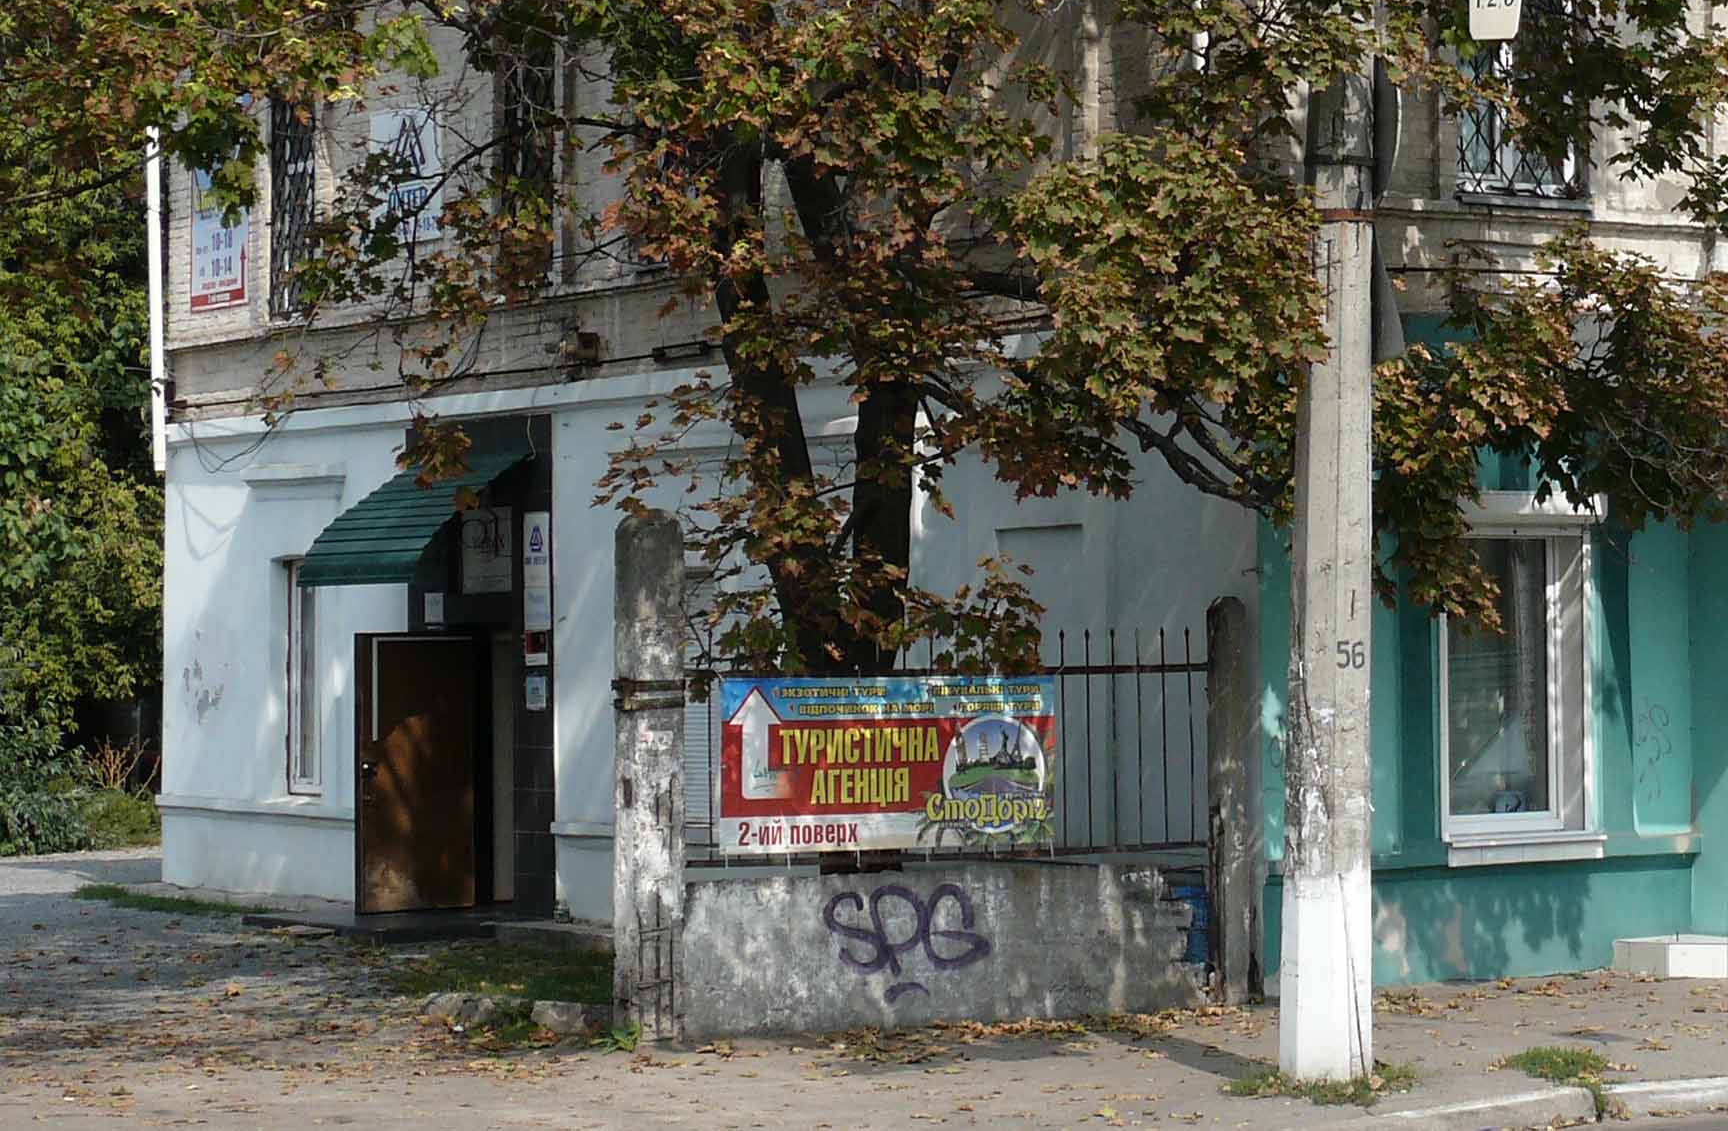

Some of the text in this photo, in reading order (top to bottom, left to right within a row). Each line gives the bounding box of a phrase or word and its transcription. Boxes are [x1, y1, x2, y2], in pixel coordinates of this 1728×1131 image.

[1336, 640, 1366, 669] 56
[779, 726, 940, 766] ТУРИСТИЧНА
[810, 768, 910, 807] АГЕНЦІЯ
[738, 819, 858, 846] 2-ий поверх
